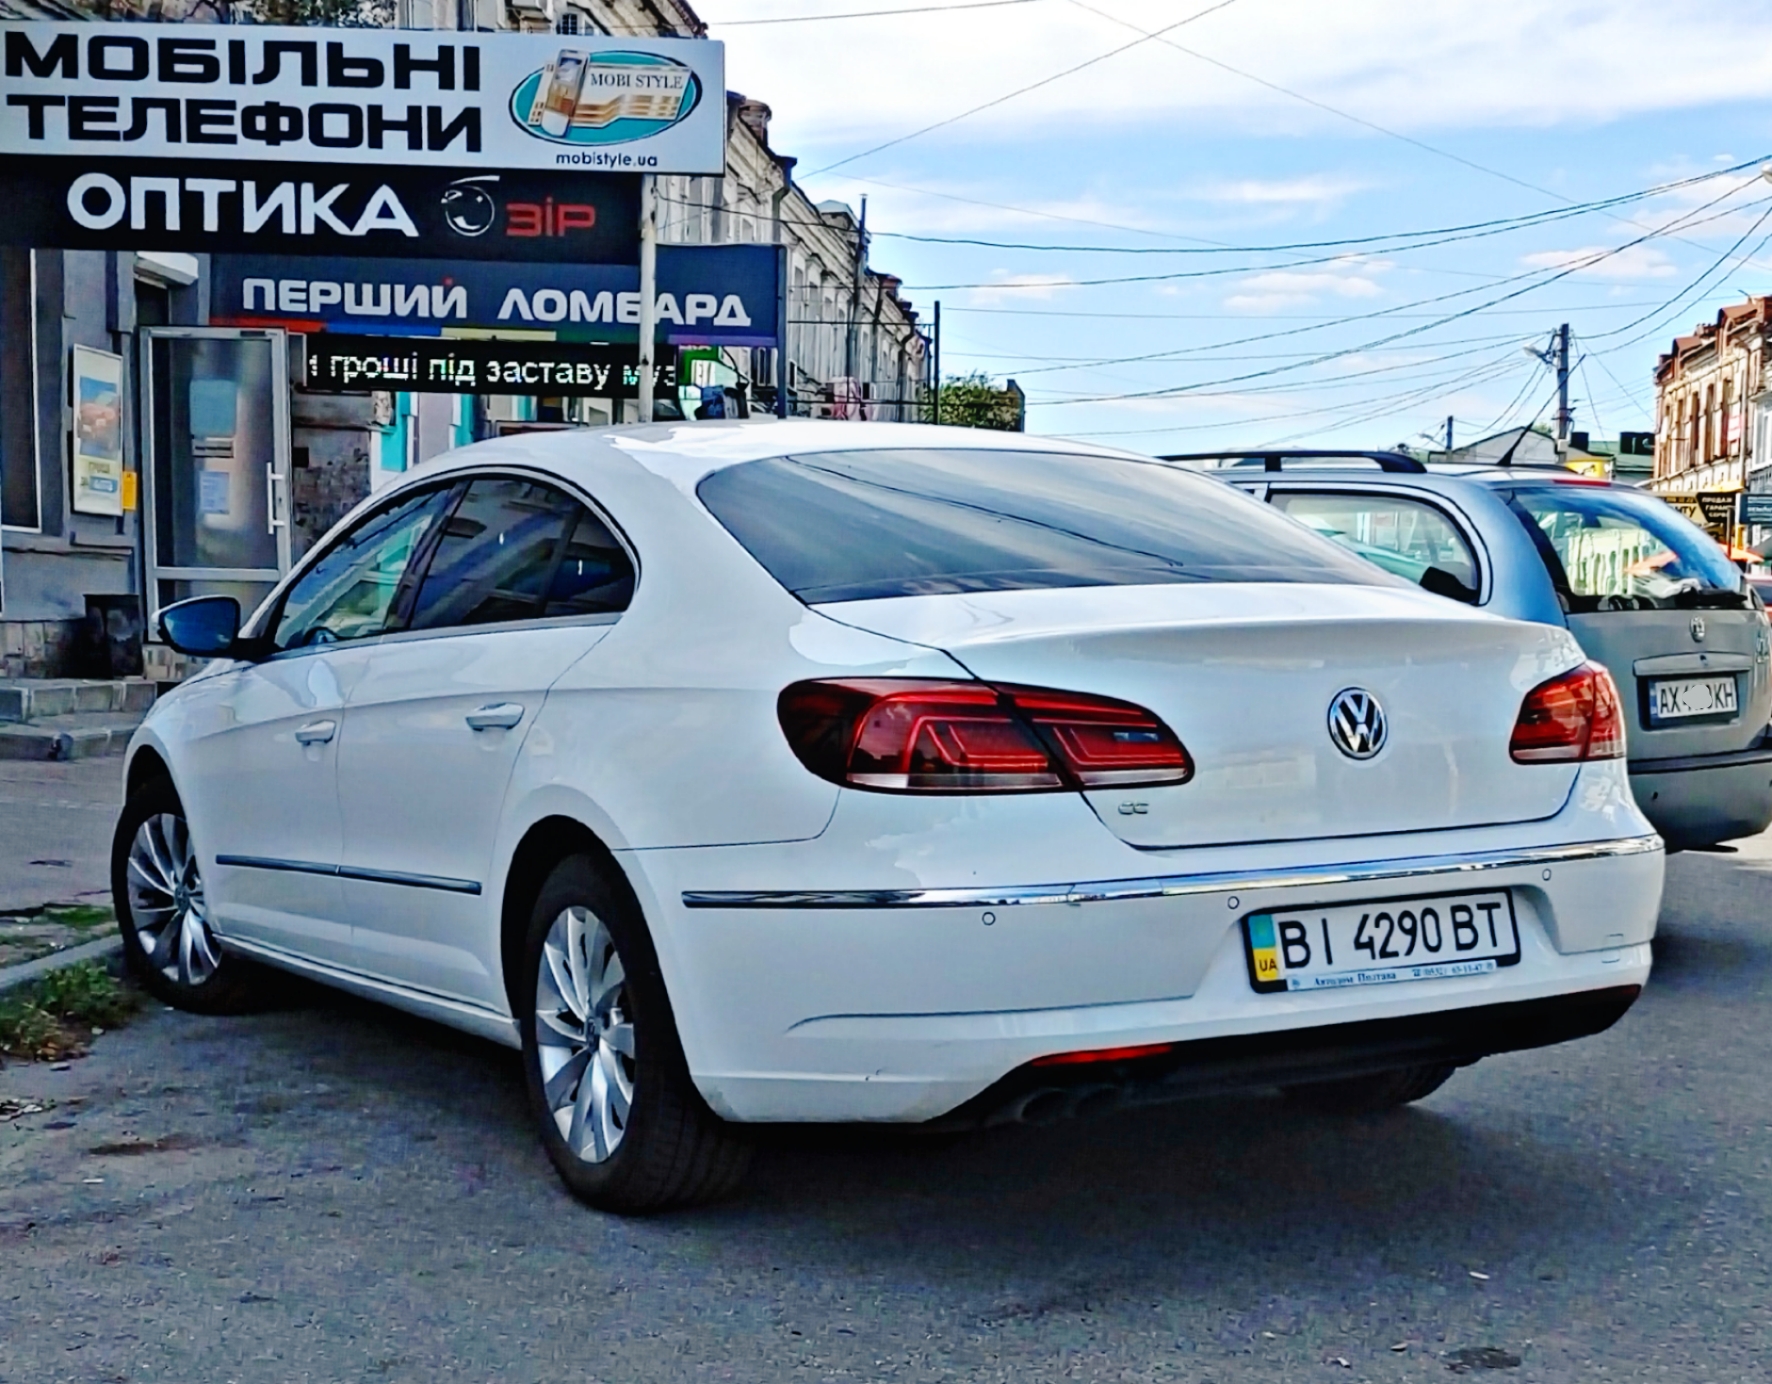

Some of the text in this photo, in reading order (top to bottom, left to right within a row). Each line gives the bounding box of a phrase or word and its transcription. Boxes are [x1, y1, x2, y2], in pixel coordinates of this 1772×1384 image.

[4, 31, 481, 91] МОБІЛЬНІ
[591, 72, 683, 89] MOBI STYLE
[6, 95, 482, 152] ТЕЛЕФОНИ
[556, 151, 658, 168] mobistyle.ua
[67, 173, 420, 238] ОПТИКА
[242, 276, 752, 327] ПЕРШИЙ ЛОМБАРД
[330, 352, 418, 384] гроші
[428, 353, 476, 387] під
[486, 361, 611, 391] заставу
[1353, 907, 1442, 960] 4290
[1259, 957, 1278, 972] UA
